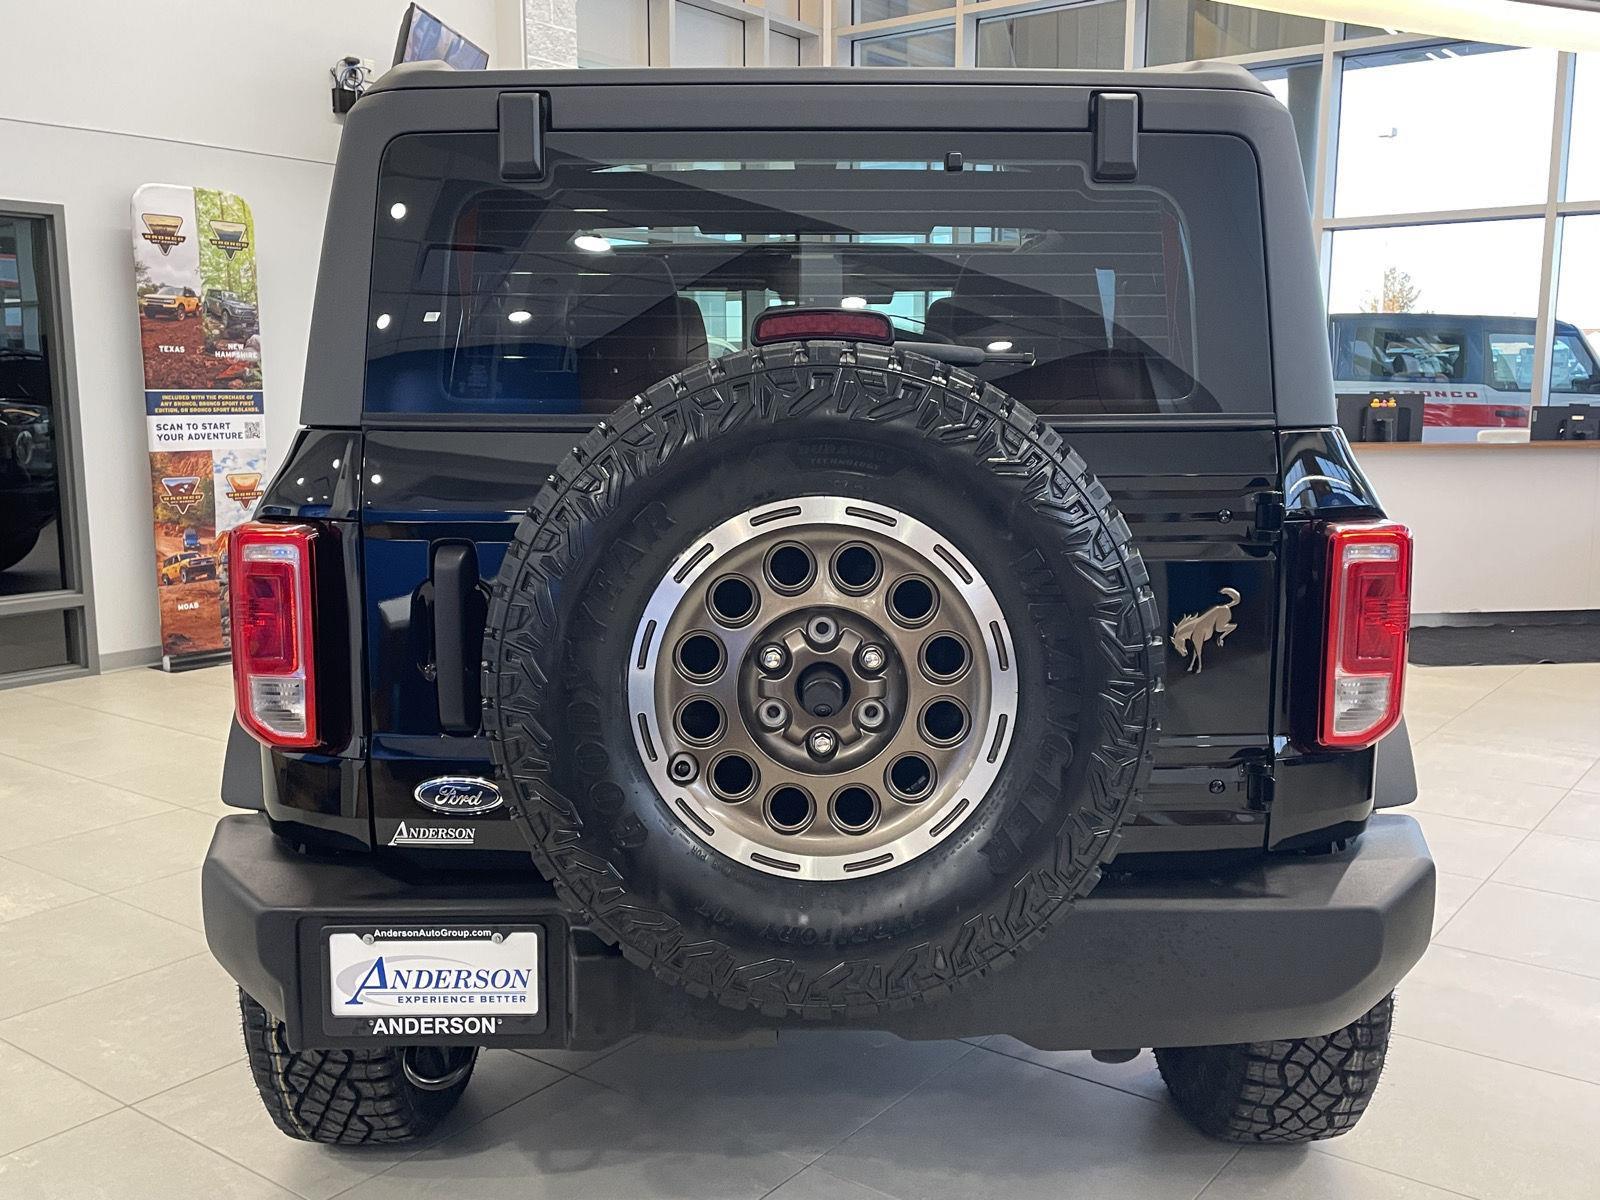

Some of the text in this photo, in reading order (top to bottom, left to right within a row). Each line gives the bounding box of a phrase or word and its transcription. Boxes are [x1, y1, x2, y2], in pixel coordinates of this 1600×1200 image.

[158, 345, 185, 353] TEXAS
[214, 351, 258, 359] HAMPSHIRE
[156, 423, 183, 431] SCAN
[201, 422, 230, 430] START
[188, 432, 243, 440] ADVENTURE
[178, 602, 199, 611] MOAB
[435, 785, 482, 805] Ford
[388, 821, 475, 845] ANDERSON
[374, 929, 492, 938] AndersonAutoGroup.com
[345, 956, 532, 1005] ANDERSON
[398, 995, 526, 1004] EXPERIENCE BETTER
[372, 1017, 496, 1035] ANDERSON
